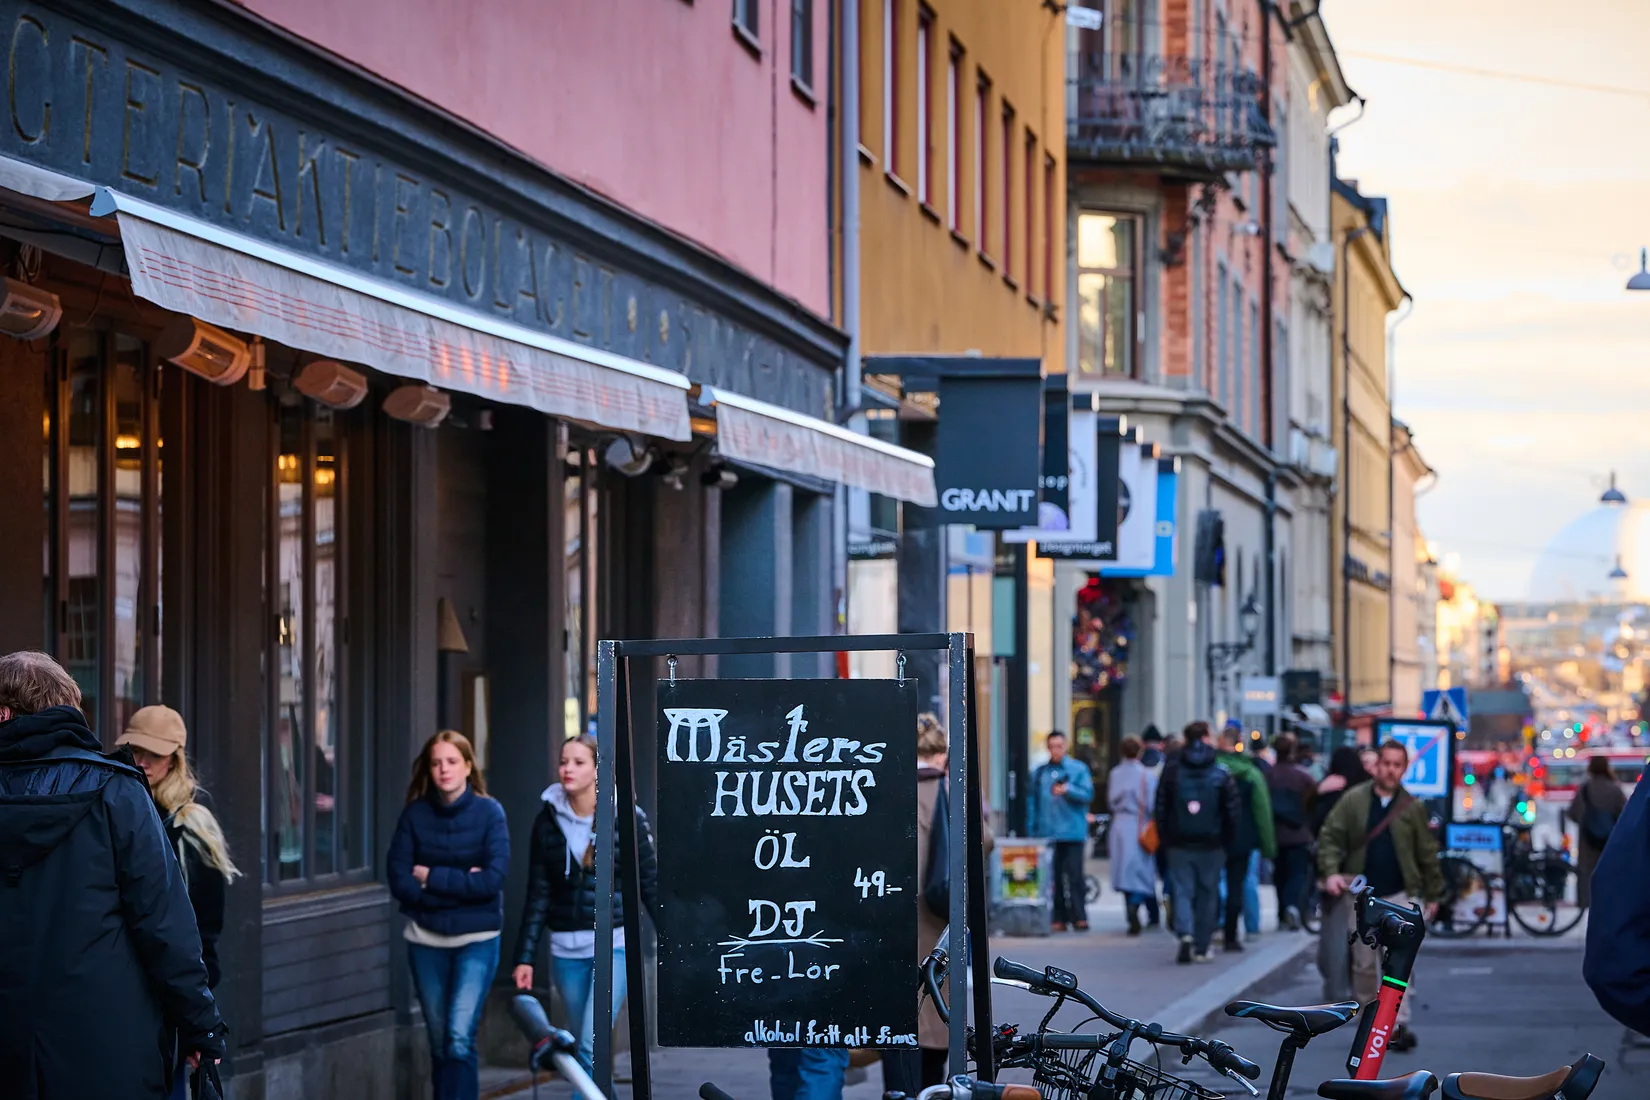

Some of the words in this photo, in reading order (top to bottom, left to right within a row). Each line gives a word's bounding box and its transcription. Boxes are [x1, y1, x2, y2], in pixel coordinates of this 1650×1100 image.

[941, 488, 1035, 512] GRANIT
[663, 703, 887, 764] Mästers
[710, 769, 876, 817] HUSETS
[754, 829, 810, 870] ÖL
[748, 898, 816, 937] DJ
[788, 950, 840, 980] Lör
[744, 1019, 801, 1044] alkohol
